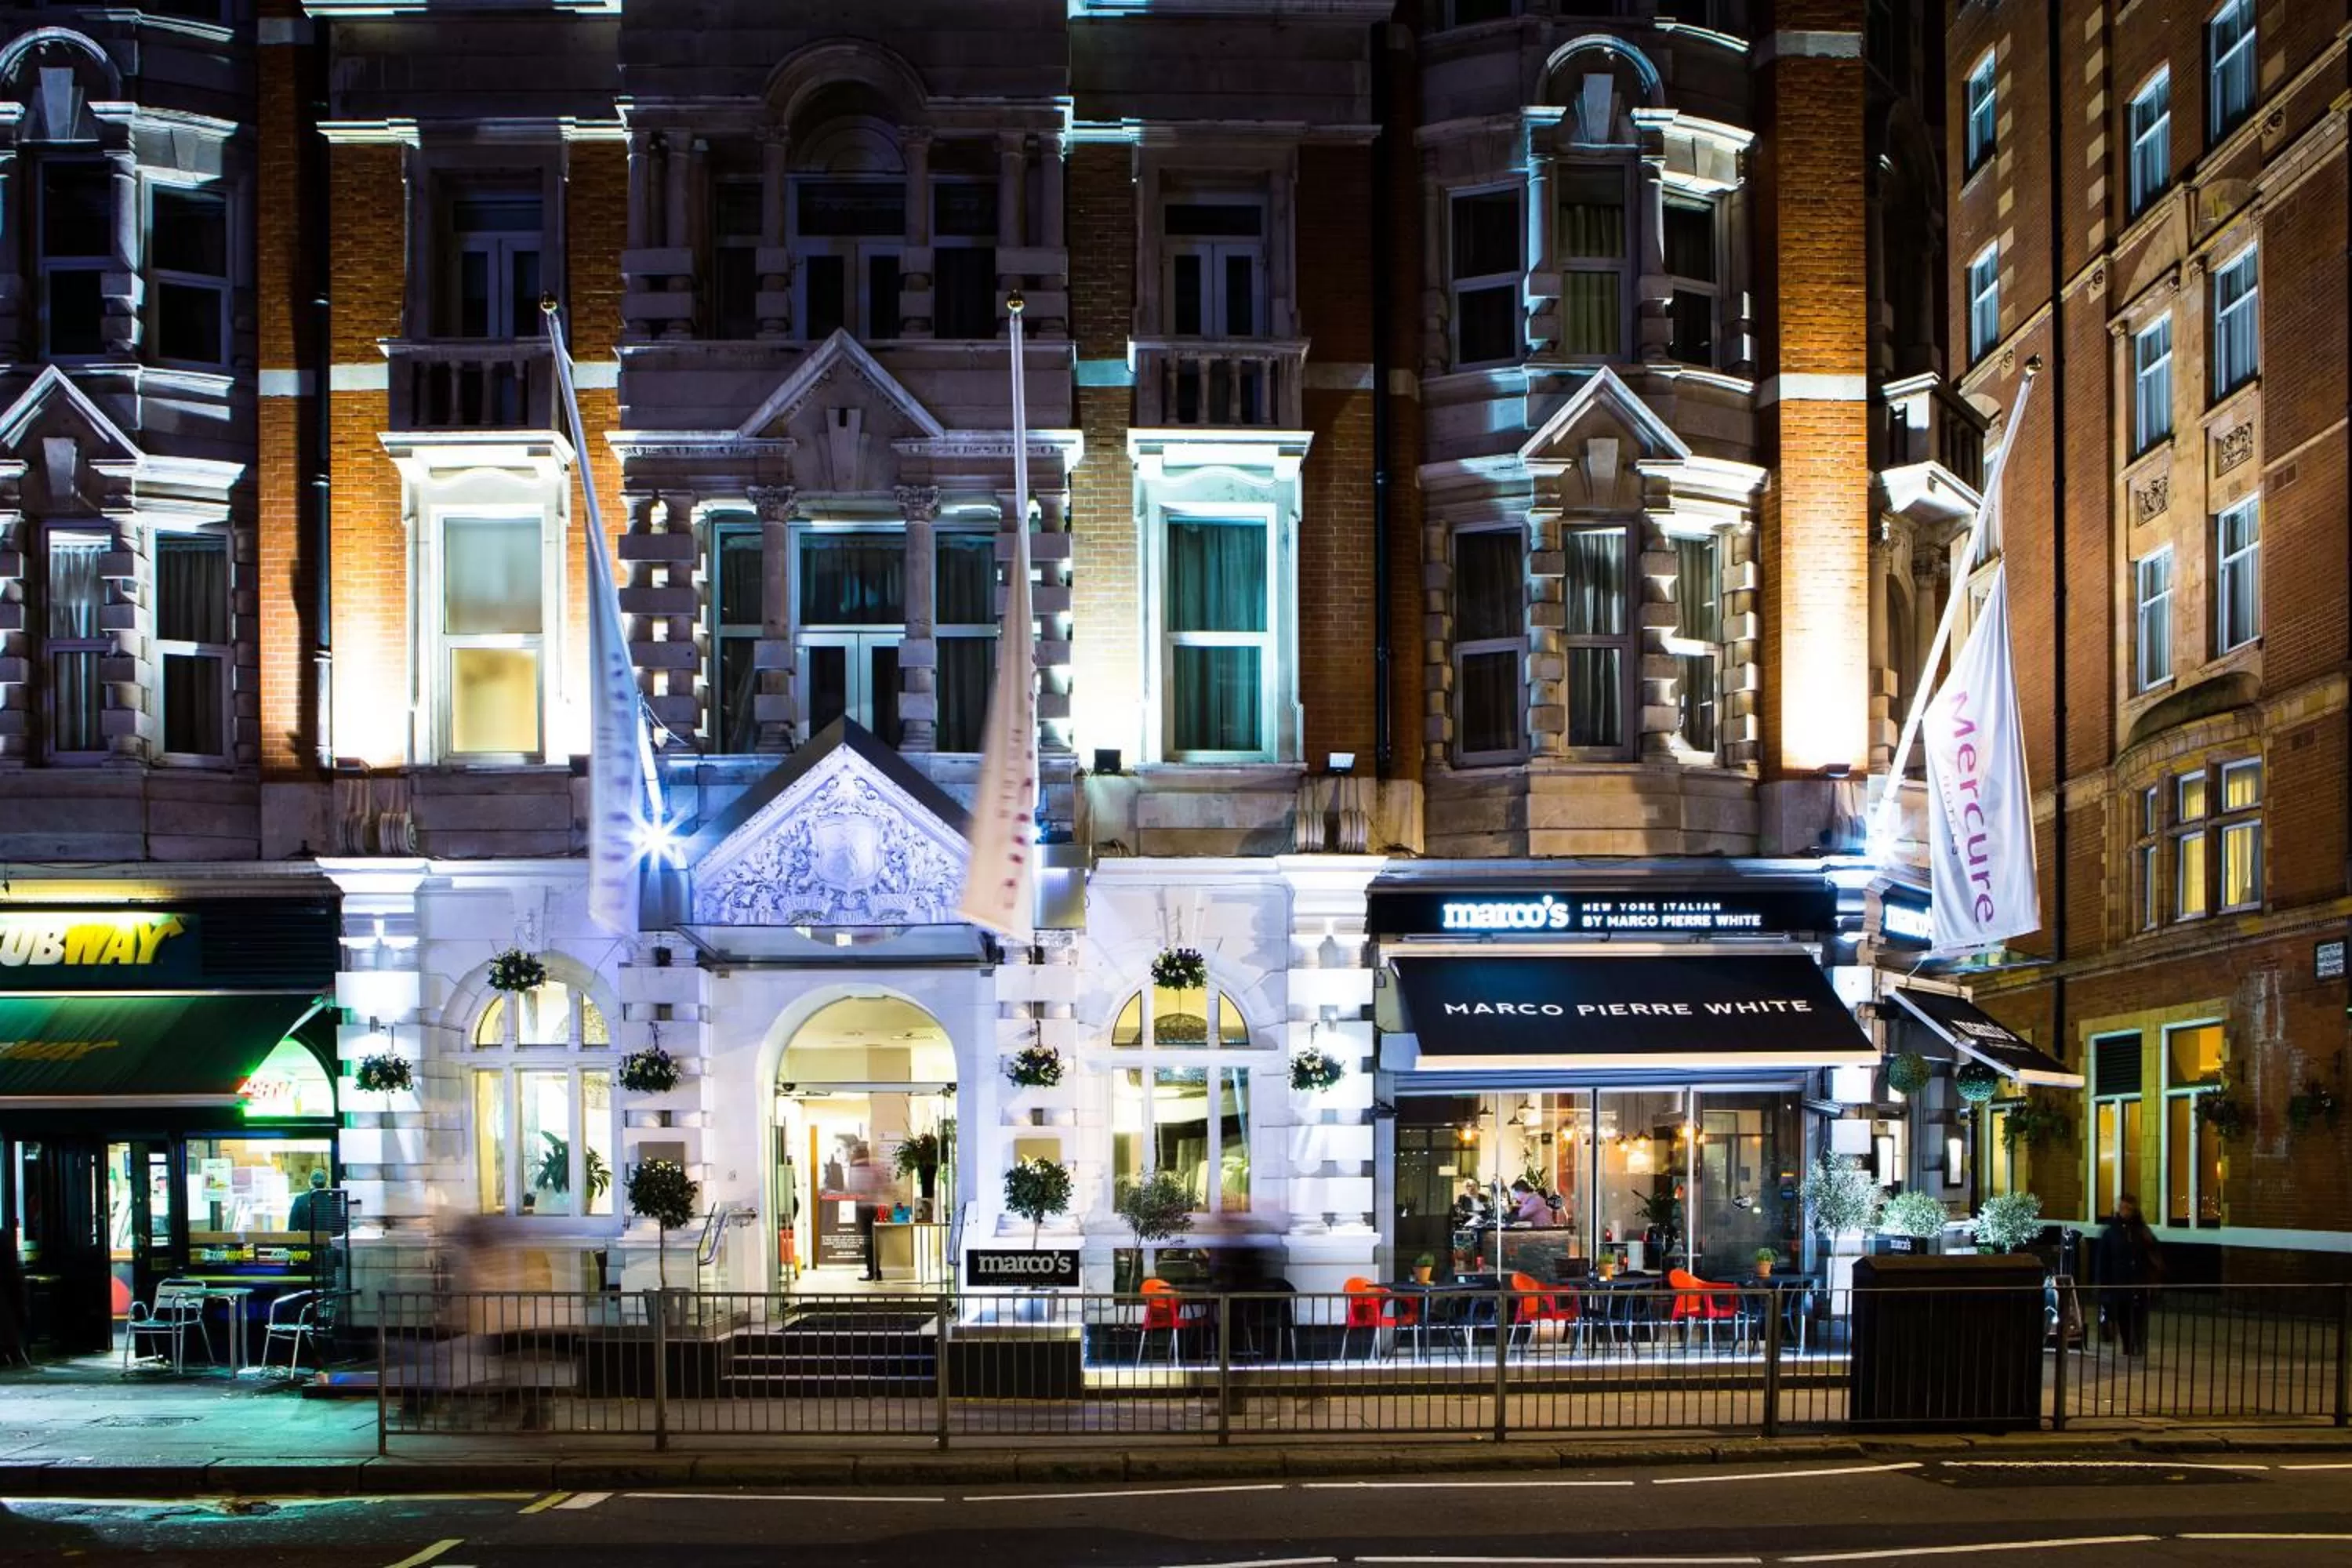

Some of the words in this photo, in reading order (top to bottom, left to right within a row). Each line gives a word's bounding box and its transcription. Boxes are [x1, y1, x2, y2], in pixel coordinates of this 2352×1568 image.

[1951, 691, 1994, 924] Mercure
[1443, 895, 1570, 928] marco's
[1581, 902, 1612, 913] NEW
[1619, 902, 1655, 913] YORK
[1663, 902, 1721, 913] ITALIAN
[1581, 915, 1603, 927] BY
[1606, 915, 1659, 927] MARCO
[1661, 915, 1711, 927] PIERRE
[1715, 915, 1762, 927] WHITE
[0, 916, 185, 967] UBWAY
[1443, 1002, 1564, 1016] MARCO
[1577, 1003, 1693, 1017] PIERRE
[1704, 1000, 1813, 1015] WHITE
[978, 1250, 1072, 1274] marco's
